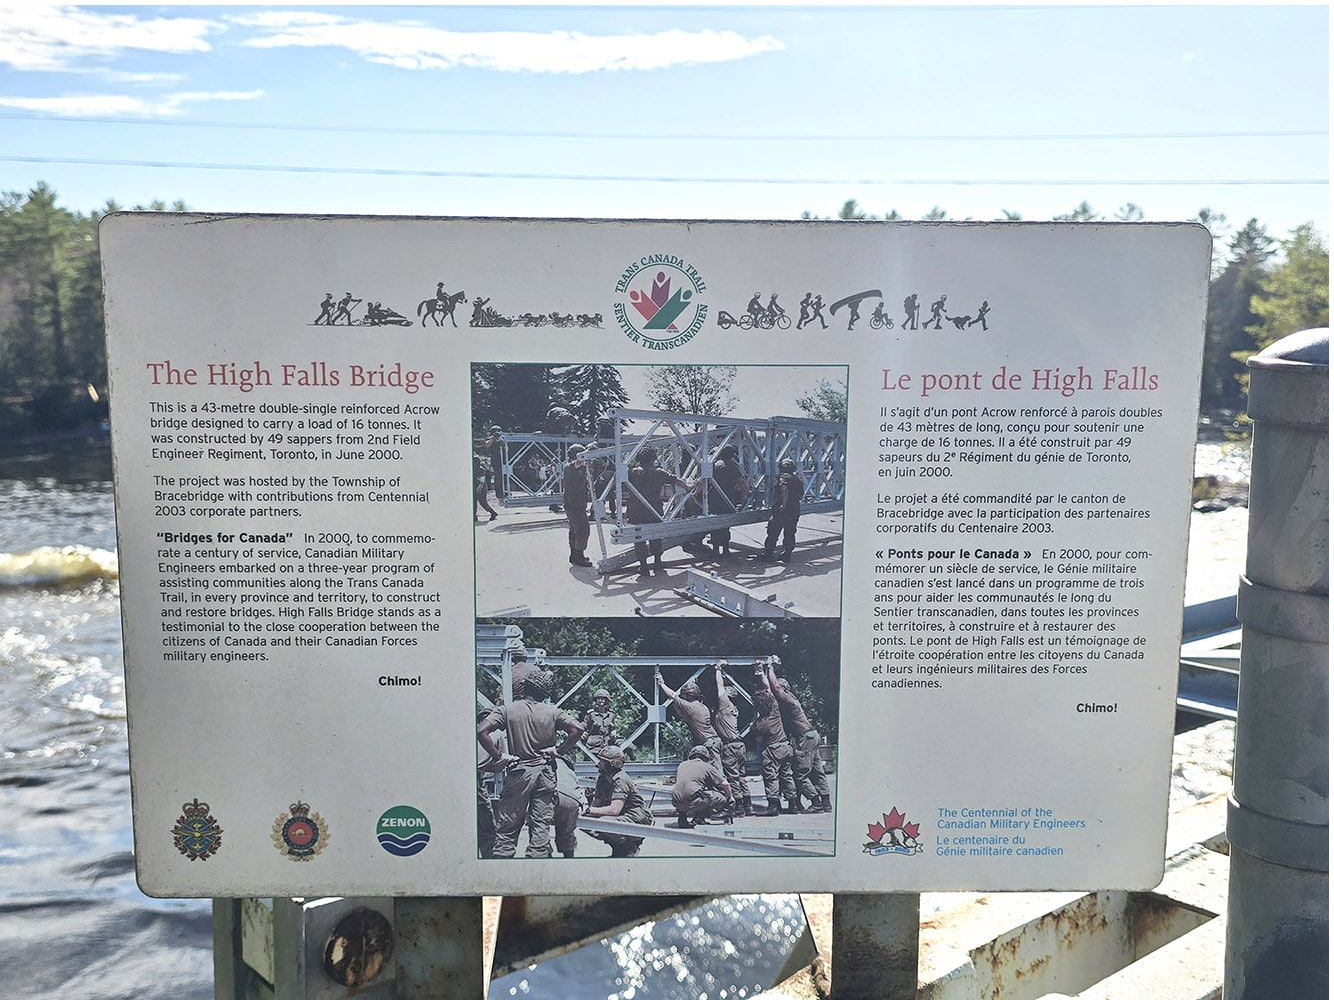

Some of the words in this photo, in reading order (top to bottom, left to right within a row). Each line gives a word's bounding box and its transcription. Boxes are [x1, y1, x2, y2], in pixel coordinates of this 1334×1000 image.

[615, 263, 640, 293] TRANS
[641, 254, 684, 268] CANADA
[686, 264, 707, 294] TRAIL
[614, 303, 641, 344] SENTIER
[642, 304, 709, 351] TRANSCANADIEN
[147, 360, 197, 385] The
[207, 361, 272, 392] High
[281, 362, 339, 386] Falls
[349, 363, 434, 394] Bridge
[882, 369, 911, 390] Le
[921, 371, 982, 397] pont
[992, 366, 1022, 390] de
[1032, 366, 1093, 397] High
[1103, 366, 1158, 390] Falls
[149, 402, 174, 412] This
[178, 402, 186, 412] is
[201, 402, 255, 413] 43-metre
[259, 403, 337, 416] double-single
[342, 404, 399, 414] reinforced
[404, 404, 440, 414] Acrow
[881, 407, 886, 416] Il
[891, 407, 920, 419] s'agit
[924, 407, 947, 417] d'un
[952, 407, 977, 419] pont
[981, 407, 1016, 417] Acrow
[1020, 406, 1067, 417] renforcé
[1071, 406, 1077, 417] à
[1082, 407, 1115, 419] parois
[1119, 408, 1162, 417] doubles
[150, 418, 187, 430] bridge
[192, 418, 243, 430] designed
[248, 418, 259, 428] to
[263, 420, 293, 431] carry
[298, 421, 304, 429] a
[308, 419, 332, 429] load
[337, 419, 348, 429] of
[352, 419, 364, 429] 16
[368, 419, 409, 430] tonnes.
[414, 420, 421, 430] It
[880, 422, 893, 432] de
[897, 422, 912, 432] 43
[916, 422, 954, 432] mètres
[959, 422, 972, 432] de
[976, 422, 1003, 434] long,
[1007, 424, 1040, 434] conçu
[1044, 424, 1070, 434] pour
[1074, 422, 1120, 432] soutenir
[1124, 424, 1144, 432] une
[151, 435, 173, 443] was
[177, 434, 246, 444] constructed
[250, 434, 264, 446] by
[268, 434, 283, 444] 49
[287, 436, 332, 446] sappers
[336, 434, 363, 444] from
[368, 434, 389, 444] 2nd
[394, 435, 420, 445] Field
[880, 437, 918, 449] charge
[921, 437, 935, 447] de
[939, 437, 950, 447] 16
[954, 437, 994, 447] tonnes.
[999, 437, 1004, 447] Il
[1009, 439, 1015, 447] a
[1019, 436, 1037, 447] été
[1041, 437, 1090, 447] construit
[1095, 439, 1113, 449] par
[1116, 437, 1131, 447] 49
[152, 448, 204, 461] Engineer
[208, 449, 266, 461] Regiment,
[270, 449, 317, 460] Toronto,
[322, 449, 331, 459] in
[336, 450, 364, 459] June
[368, 450, 402, 460] 2000.
[379, 676, 421, 686] Chimo!
[1076, 703, 1117, 712] Chimo!
[938, 808, 957, 817] The
[961, 808, 1017, 817] Centennial
[1021, 808, 1032, 817] of
[1036, 808, 1052, 817] the
[381, 817, 425, 828] ZENON
[938, 819, 986, 829] Canadian
[990, 819, 1030, 830] Military
[1034, 819, 1086, 830] Engineers
[937, 836, 950, 845] Le
[953, 835, 1009, 845] centenaire
[1012, 835, 1025, 844] du
[936, 846, 966, 856] Génie
[970, 846, 1012, 856] militaire
[1016, 846, 1063, 855] canadien
